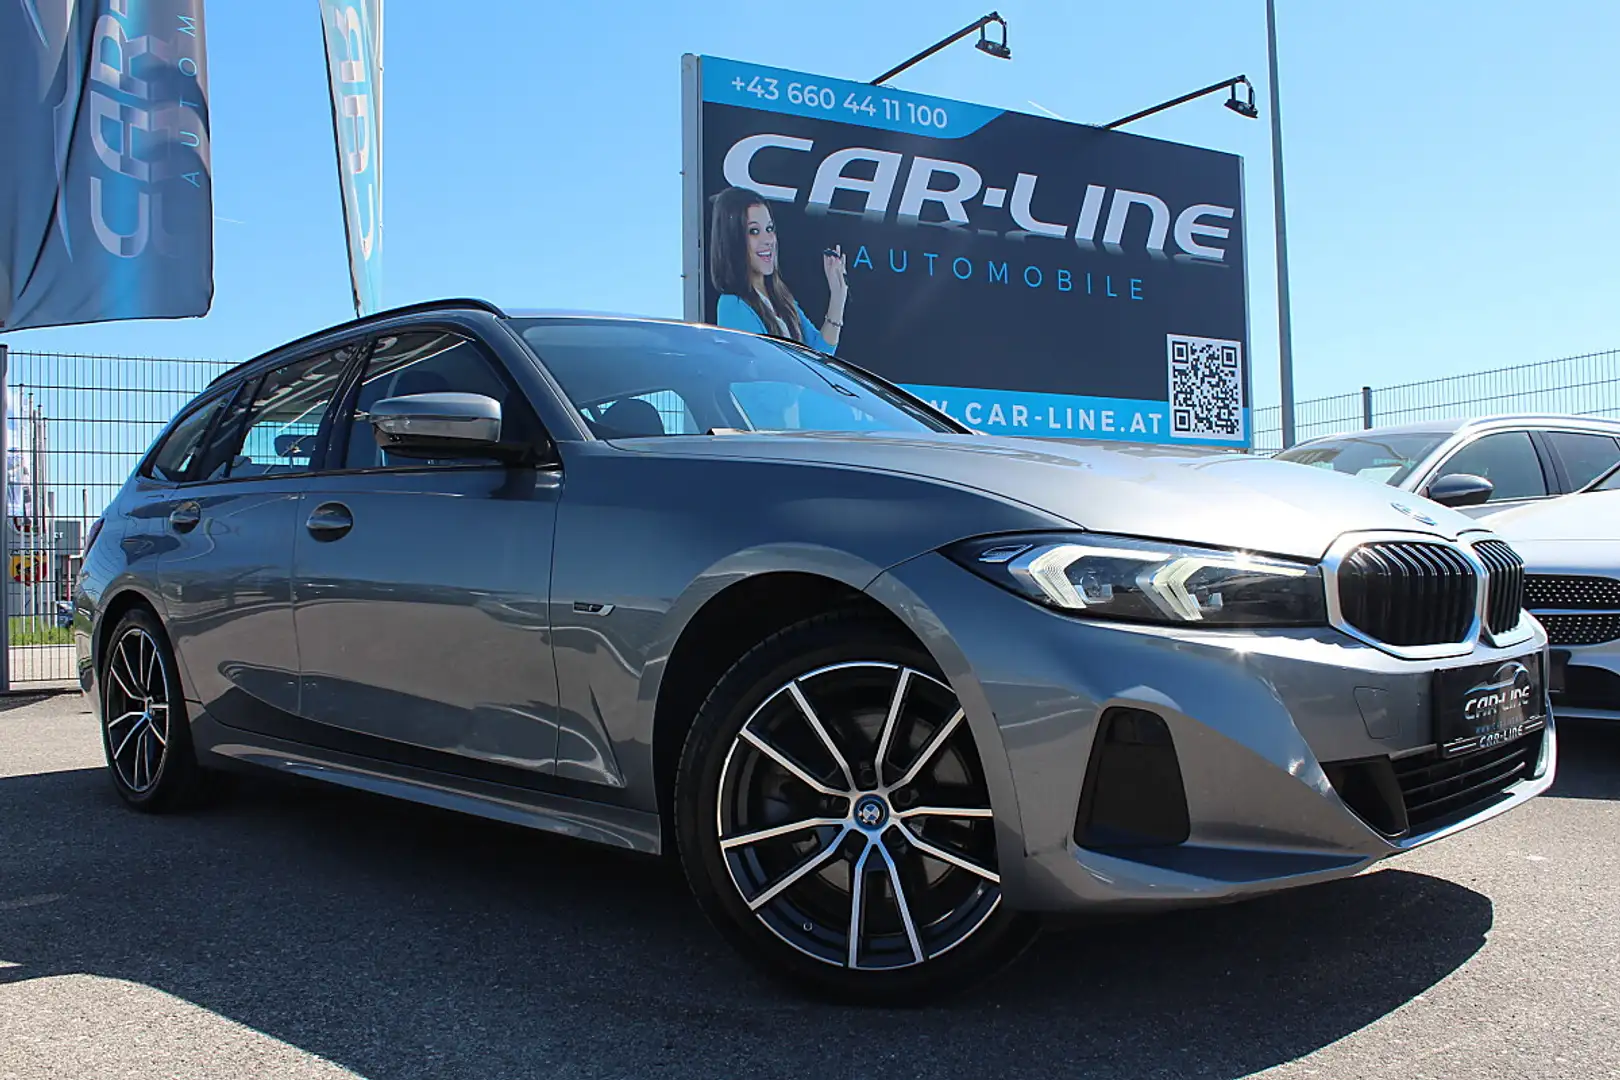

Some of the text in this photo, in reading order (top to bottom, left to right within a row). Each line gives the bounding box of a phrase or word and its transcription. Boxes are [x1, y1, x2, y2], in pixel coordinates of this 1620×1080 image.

[731, 76, 948, 129] +43 660 44 11 100
[723, 133, 1235, 262] CAR-LINE
[853, 246, 1144, 300] AUTOMOBILE
